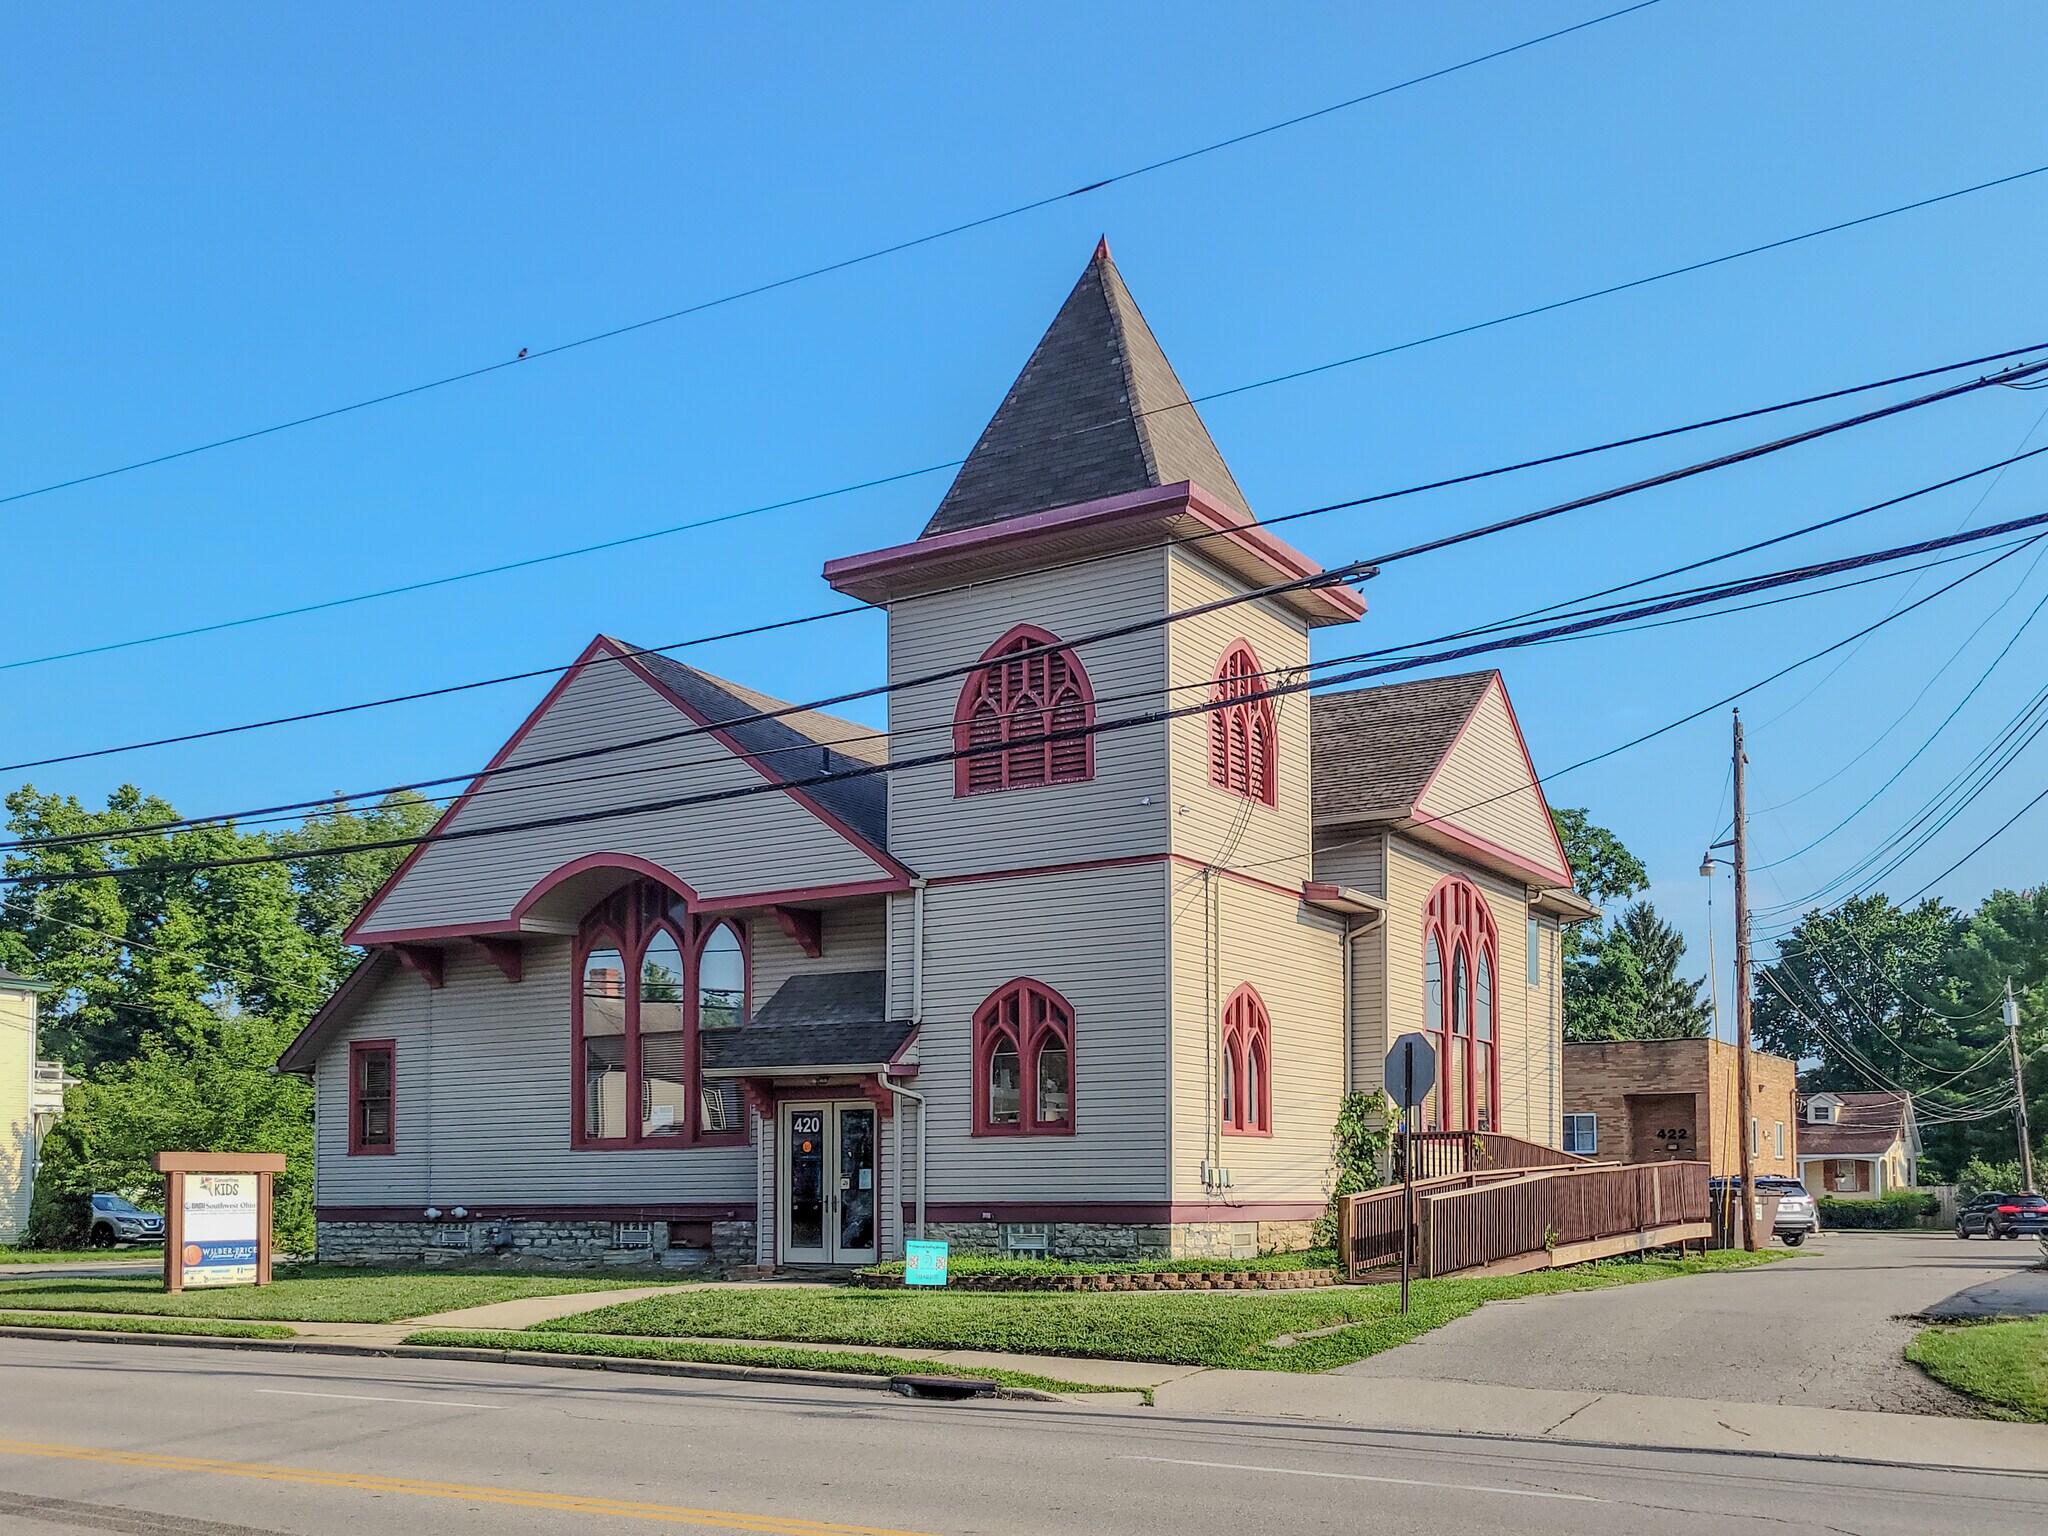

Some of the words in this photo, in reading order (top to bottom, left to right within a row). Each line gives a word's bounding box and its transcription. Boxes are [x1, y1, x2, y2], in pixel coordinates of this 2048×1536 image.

[794, 1117, 820, 1132] 420
[1657, 1129, 1688, 1139] 422
[214, 1183, 239, 1196] KIDS
